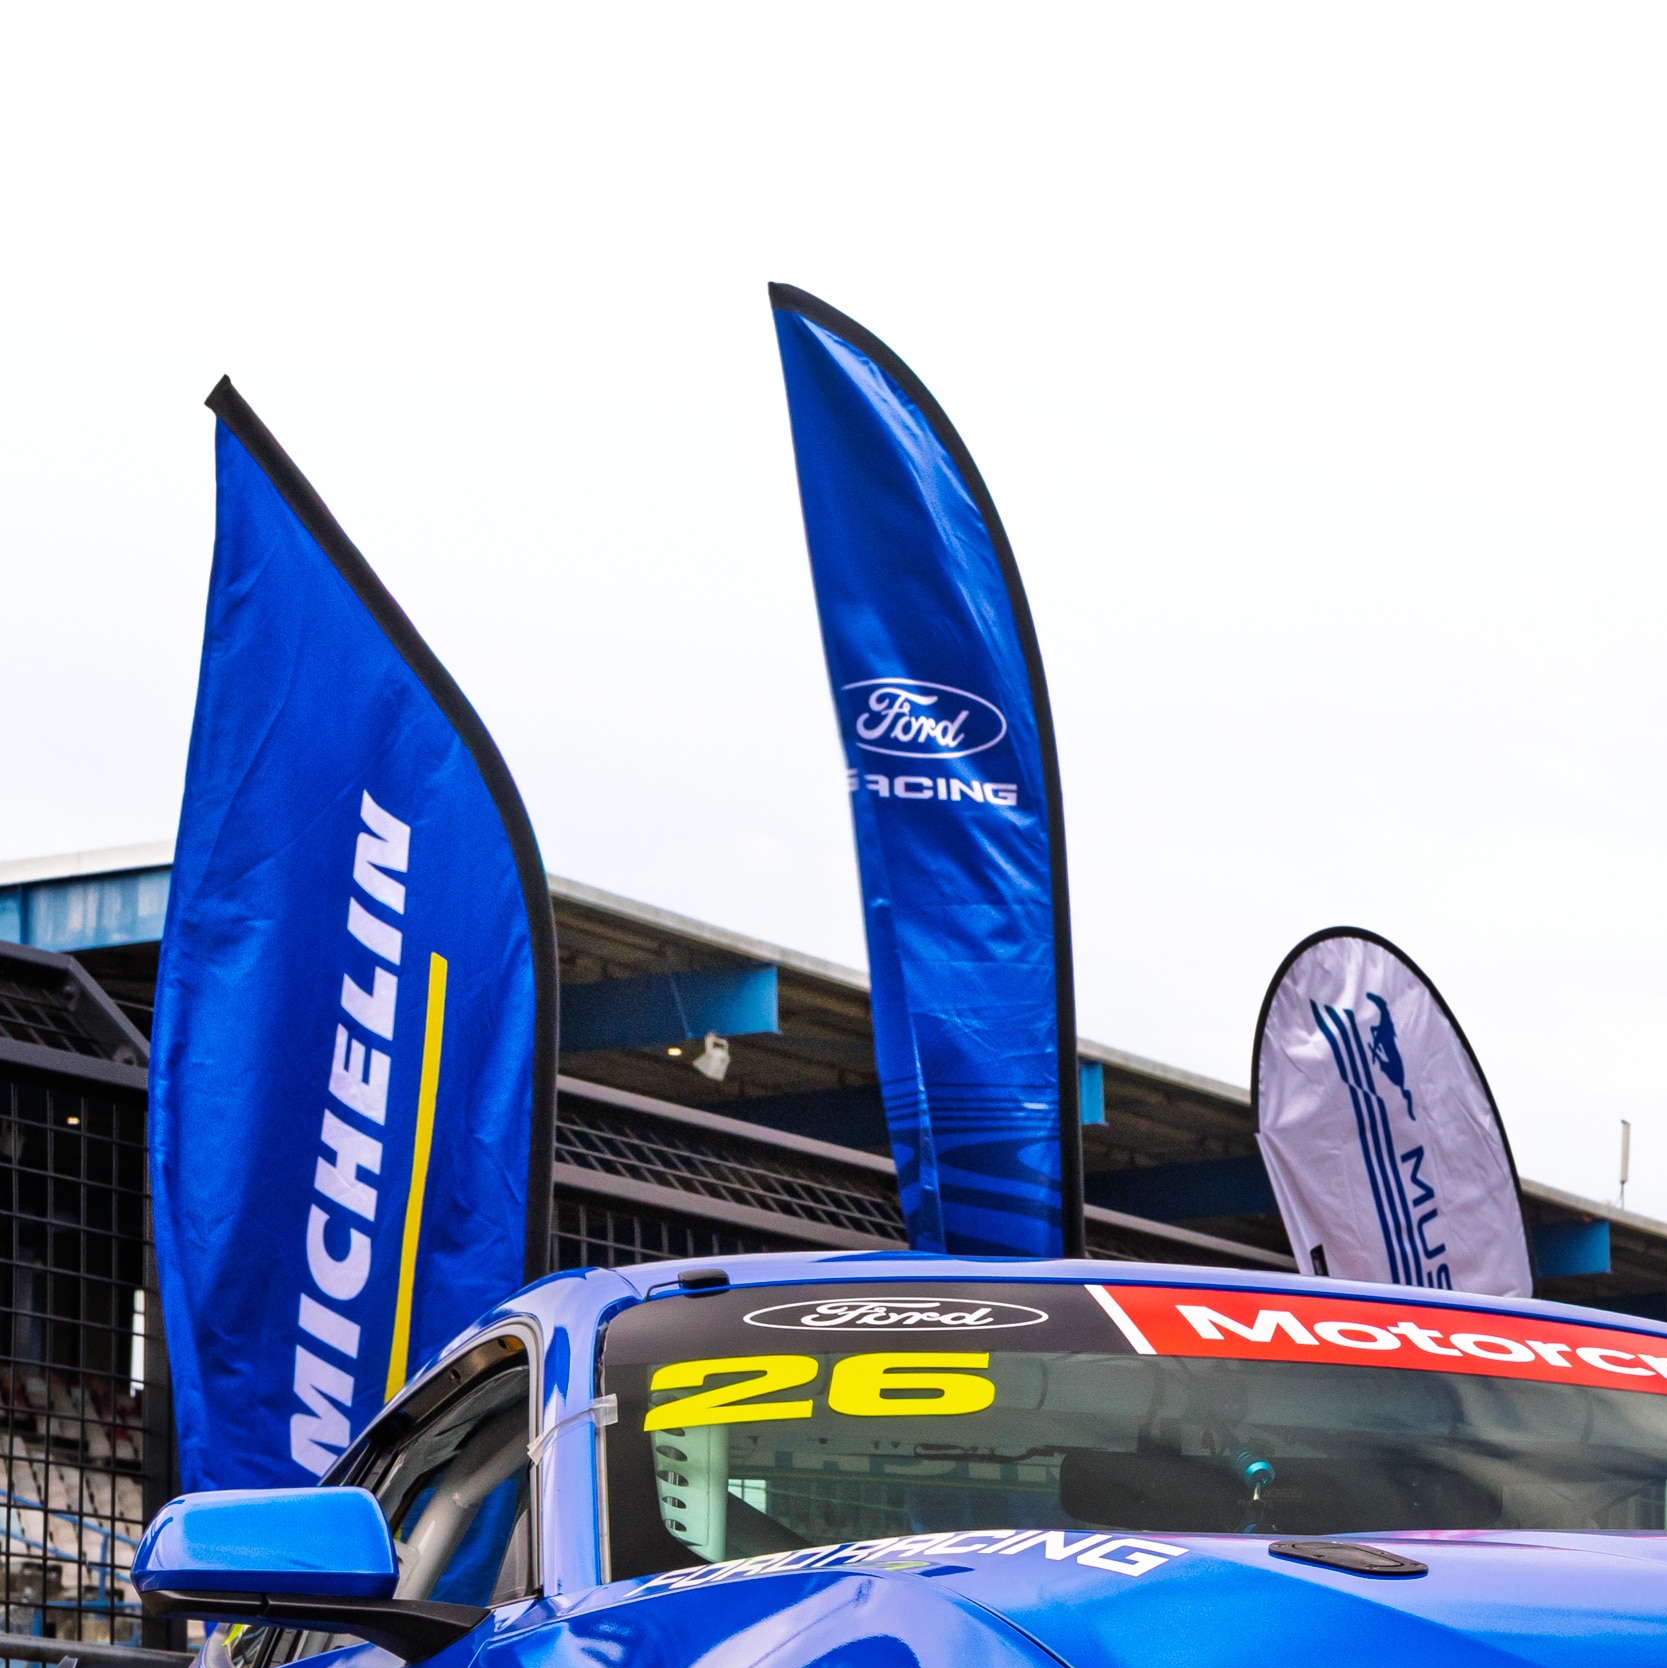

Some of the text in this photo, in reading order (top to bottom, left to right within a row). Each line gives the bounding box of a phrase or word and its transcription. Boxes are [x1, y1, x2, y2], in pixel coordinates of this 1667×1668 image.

[856, 687, 970, 748] Ford
[290, 789, 411, 1478] MICHELIN
[800, 1302, 995, 1329] Ford
[644, 1352, 995, 1431] 26
